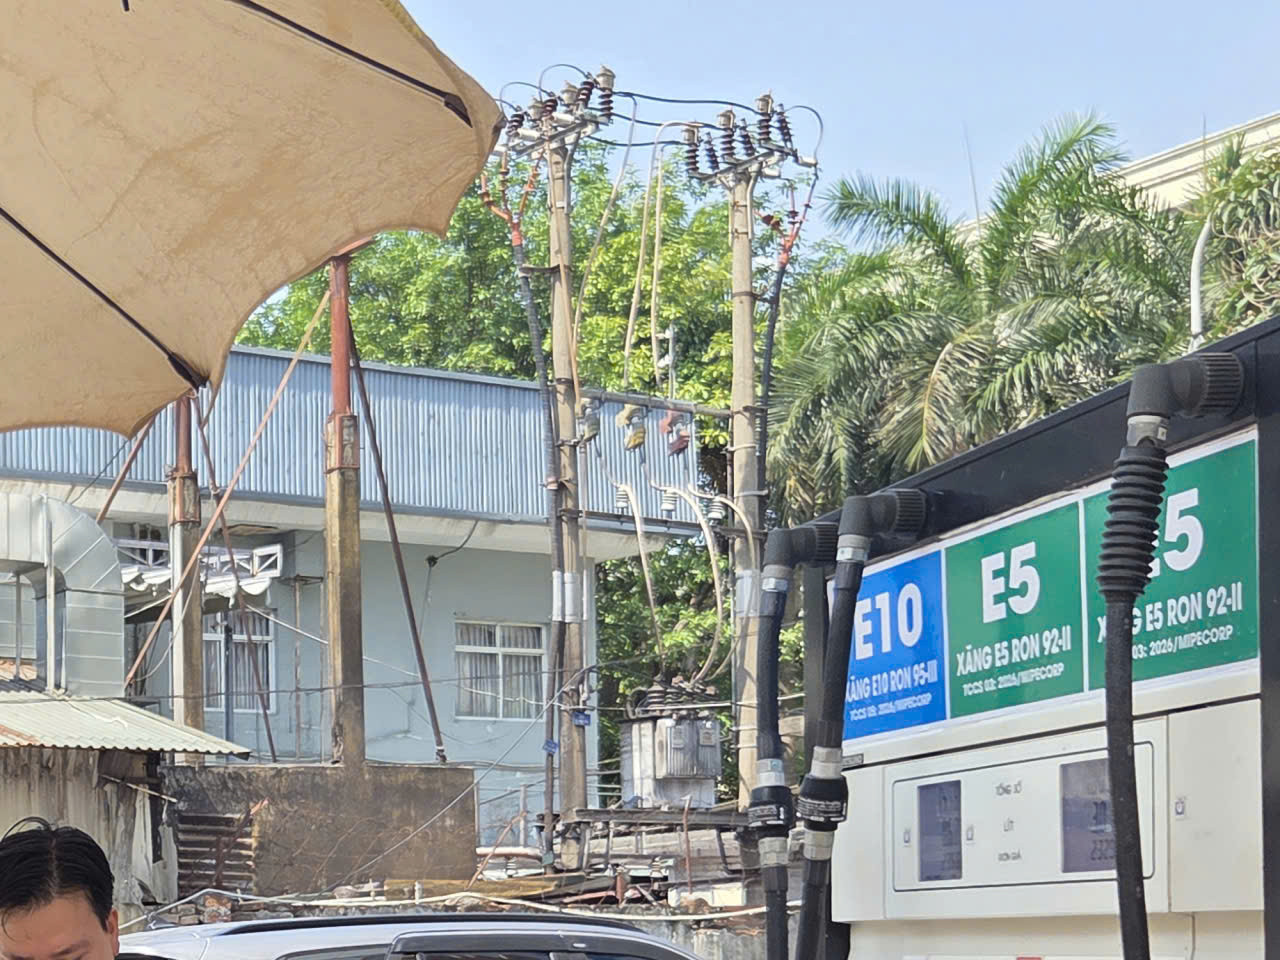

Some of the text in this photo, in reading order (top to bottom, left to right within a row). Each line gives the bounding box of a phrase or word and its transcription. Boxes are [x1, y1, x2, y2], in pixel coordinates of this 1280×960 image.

[1147, 488, 1203, 579] 5
[981, 541, 1040, 624] E5
[1097, 581, 1242, 642] XG E5 RON 92-II
[854, 583, 923, 660] E10
[956, 625, 1071, 676] XĂNG E5 RON 92-II
[872, 672, 889, 696] E10
[890, 666, 911, 692] RON
